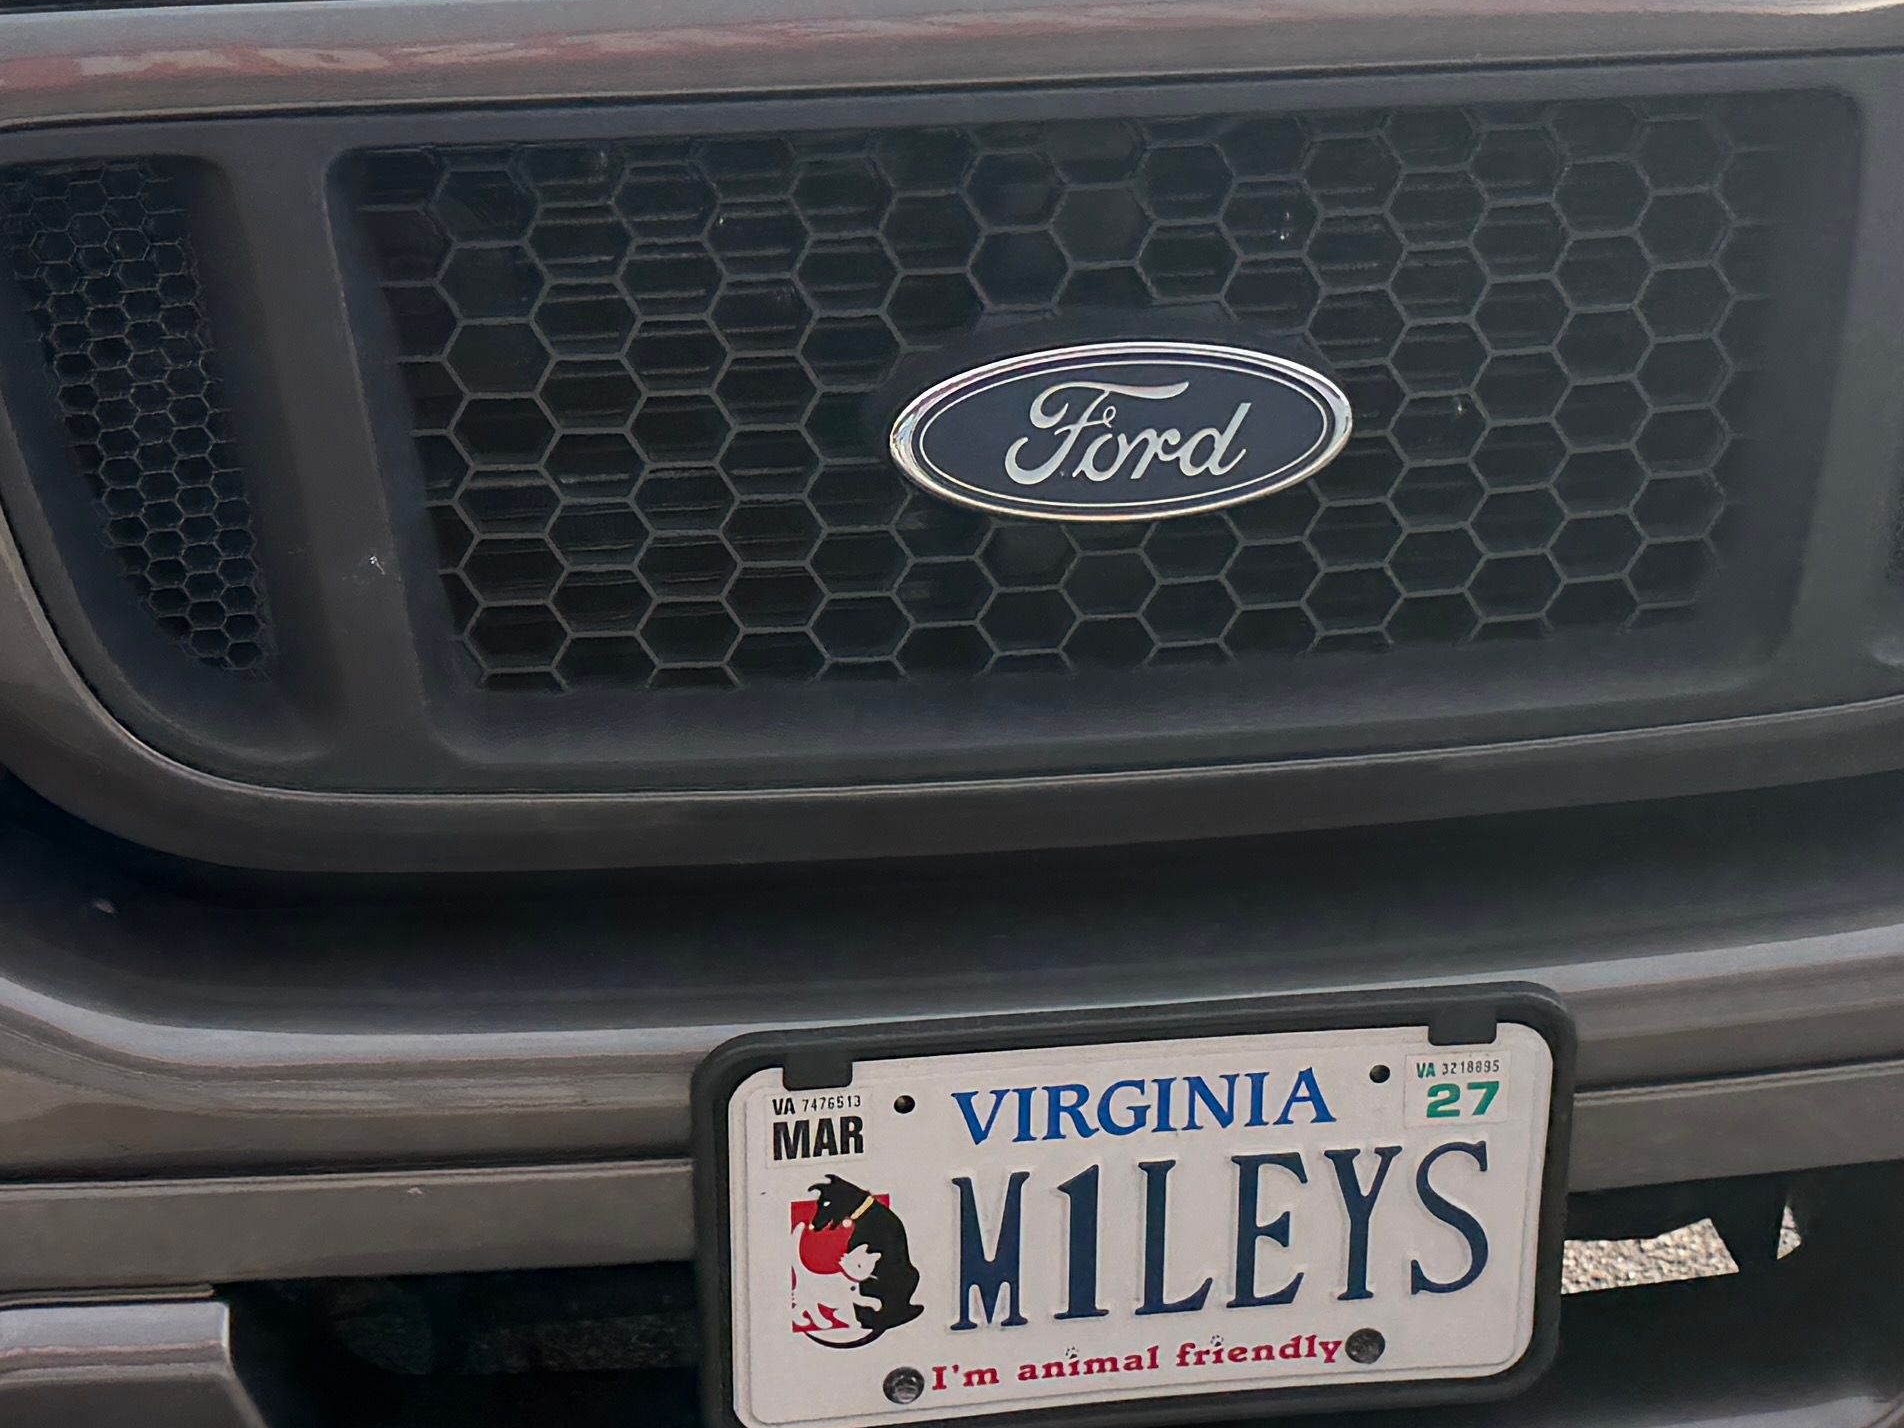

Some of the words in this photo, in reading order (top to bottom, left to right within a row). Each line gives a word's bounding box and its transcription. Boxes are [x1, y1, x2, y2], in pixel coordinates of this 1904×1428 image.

[1004, 380, 1253, 486] Ford
[1416, 1062, 1436, 1078] VA
[1442, 1059, 1500, 1075] 3218895
[772, 1097, 796, 1116] VA
[802, 1095, 861, 1113] 7476513
[951, 1066, 1337, 1146] VIRGINIA
[1426, 1080, 1500, 1118] 27
[773, 1115, 865, 1161] MAR
[950, 1140, 1489, 1331] M1LEYS
[931, 1364, 1000, 1391] I'm
[1016, 1345, 1160, 1381] animal
[1175, 1334, 1345, 1368] friendly
